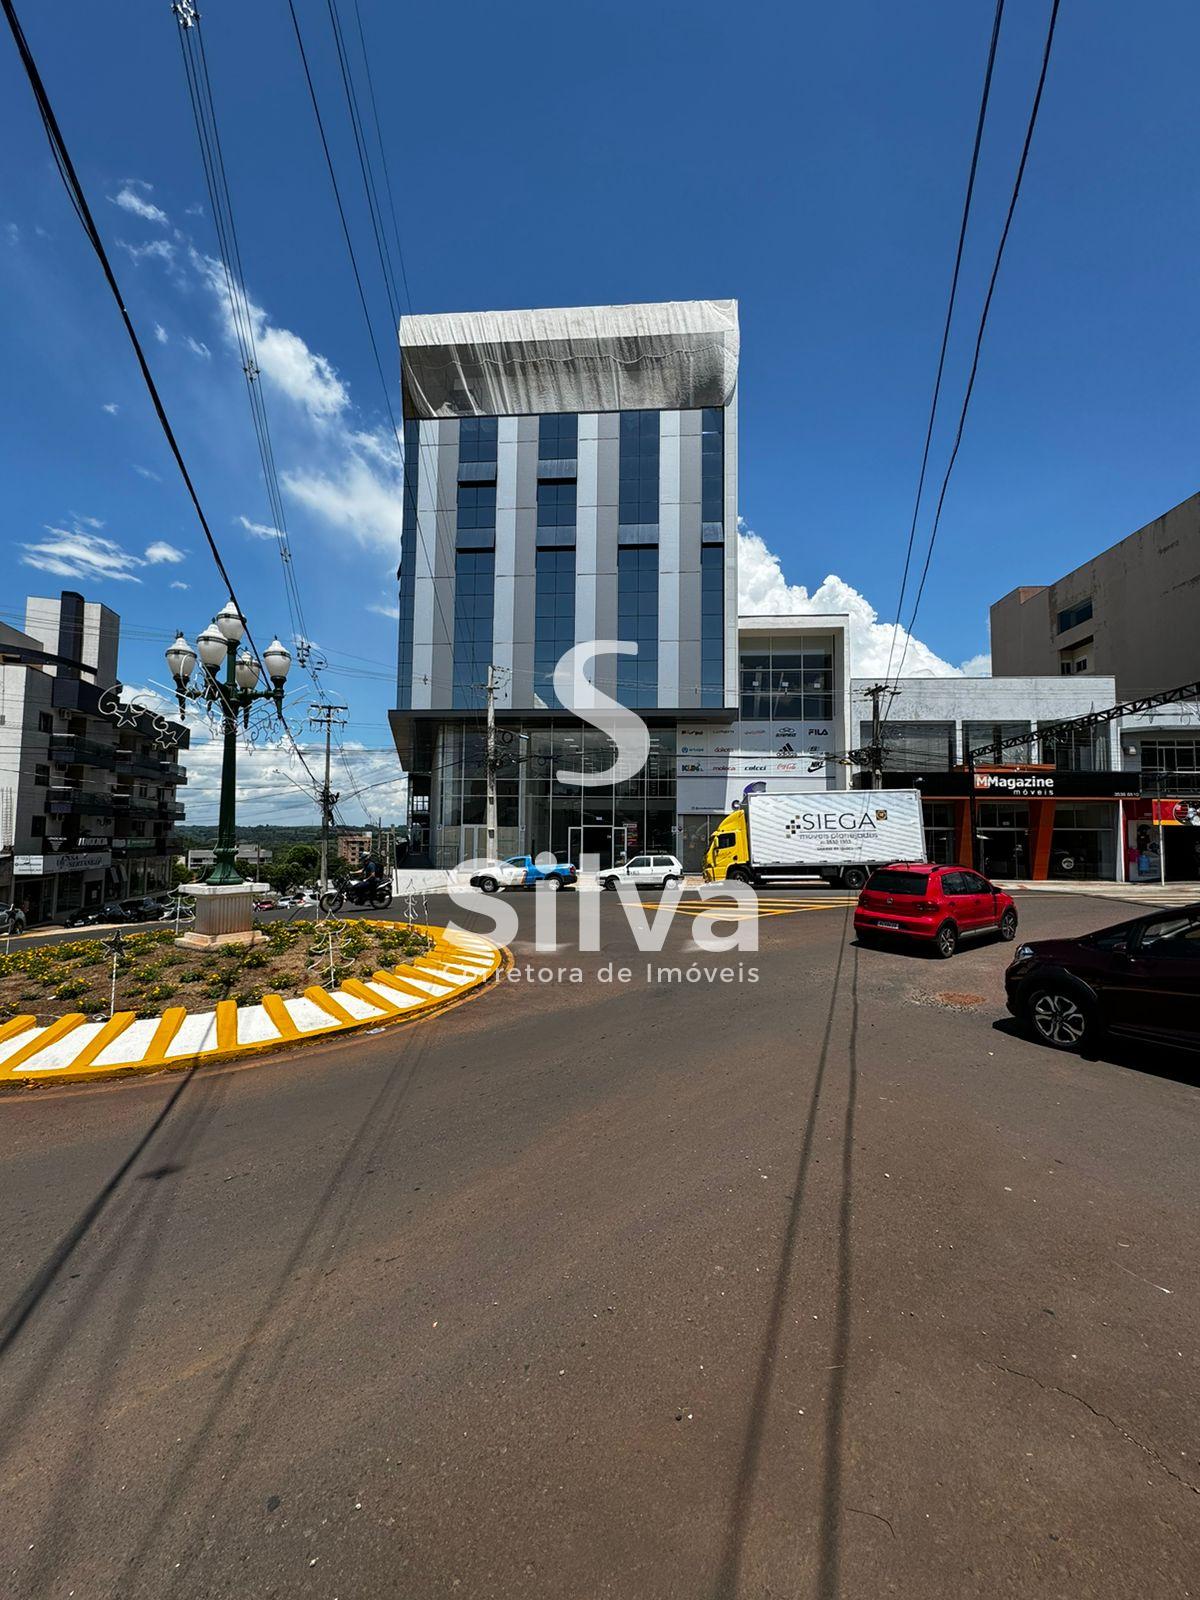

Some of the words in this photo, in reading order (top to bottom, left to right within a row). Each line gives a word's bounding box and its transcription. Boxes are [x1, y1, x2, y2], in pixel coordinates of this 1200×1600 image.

[808, 728, 829, 736] FILA
[988, 775, 1054, 790] Magazine
[802, 812, 877, 830] SIEGA
